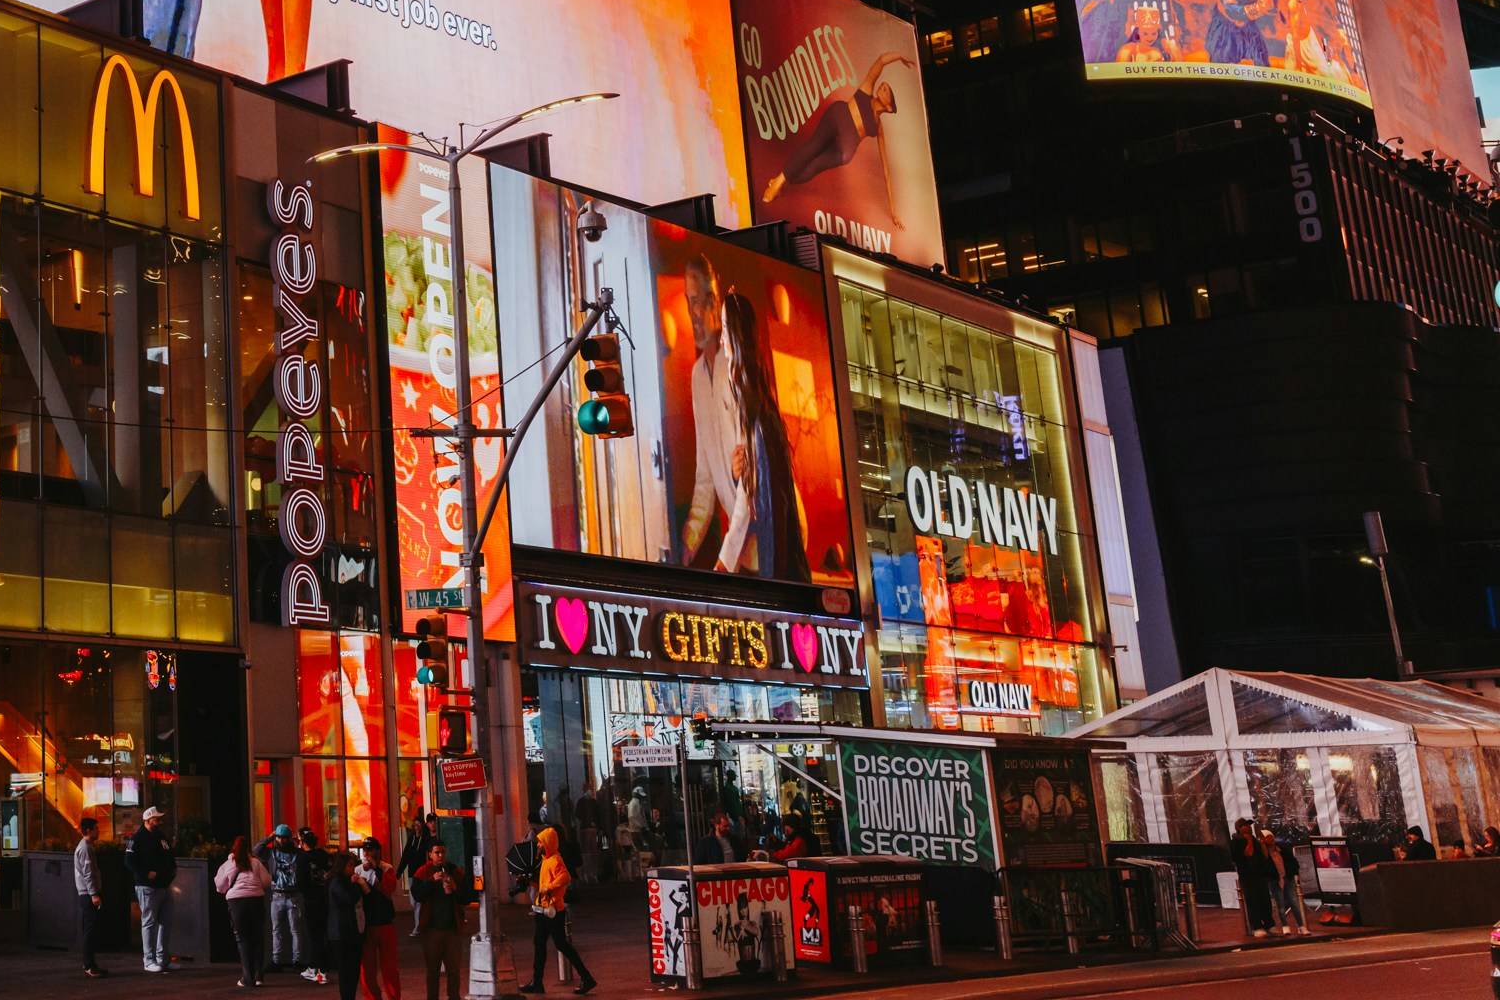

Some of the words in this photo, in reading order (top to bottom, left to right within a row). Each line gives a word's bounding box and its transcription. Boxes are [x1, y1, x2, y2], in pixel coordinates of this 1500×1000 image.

[443, 9, 498, 51] ever.
[740, 22, 762, 69] GO
[745, 25, 858, 141] BOUNDLESS
[1125, 66, 1147, 75] BUY
[1151, 66, 1183, 74] FROM
[1186, 66, 1206, 75] THE
[1209, 67, 1231, 76] BOX
[1233, 68, 1268, 79] OFFICE
[1270, 72, 1280, 80] AT
[1283, 73, 1304, 84] 42ND
[1288, 137, 1322, 243] 1500
[814, 210, 847, 239] OLD
[850, 221, 891, 255] NAVY
[906, 465, 972, 541] OLD
[977, 480, 1058, 556] NAVY
[419, 592, 430, 607] W
[435, 591, 449, 606] 45
[535, 594, 555, 650] I
[663, 611, 768, 670] GIFTS
[776, 621, 793, 670] I
[970, 680, 997, 707] OLD
[999, 683, 1032, 710] NAVY
[453, 762, 478, 771] STOPPING
[623, 748, 649, 756] PEDESTRIAN
[662, 747, 674, 755] ZONE
[853, 754, 971, 780] DISCOVER
[1004, 760, 1018, 769] DID
[1020, 760, 1034, 769] YOU
[855, 777, 977, 837] BROADWAY'S
[859, 830, 979, 864] SECRETS
[696, 876, 789, 907] CHICAGO
[870, 874, 904, 884] ADRENALINE
[647, 878, 666, 975] CHICAGO
[802, 927, 820, 943] MJ
